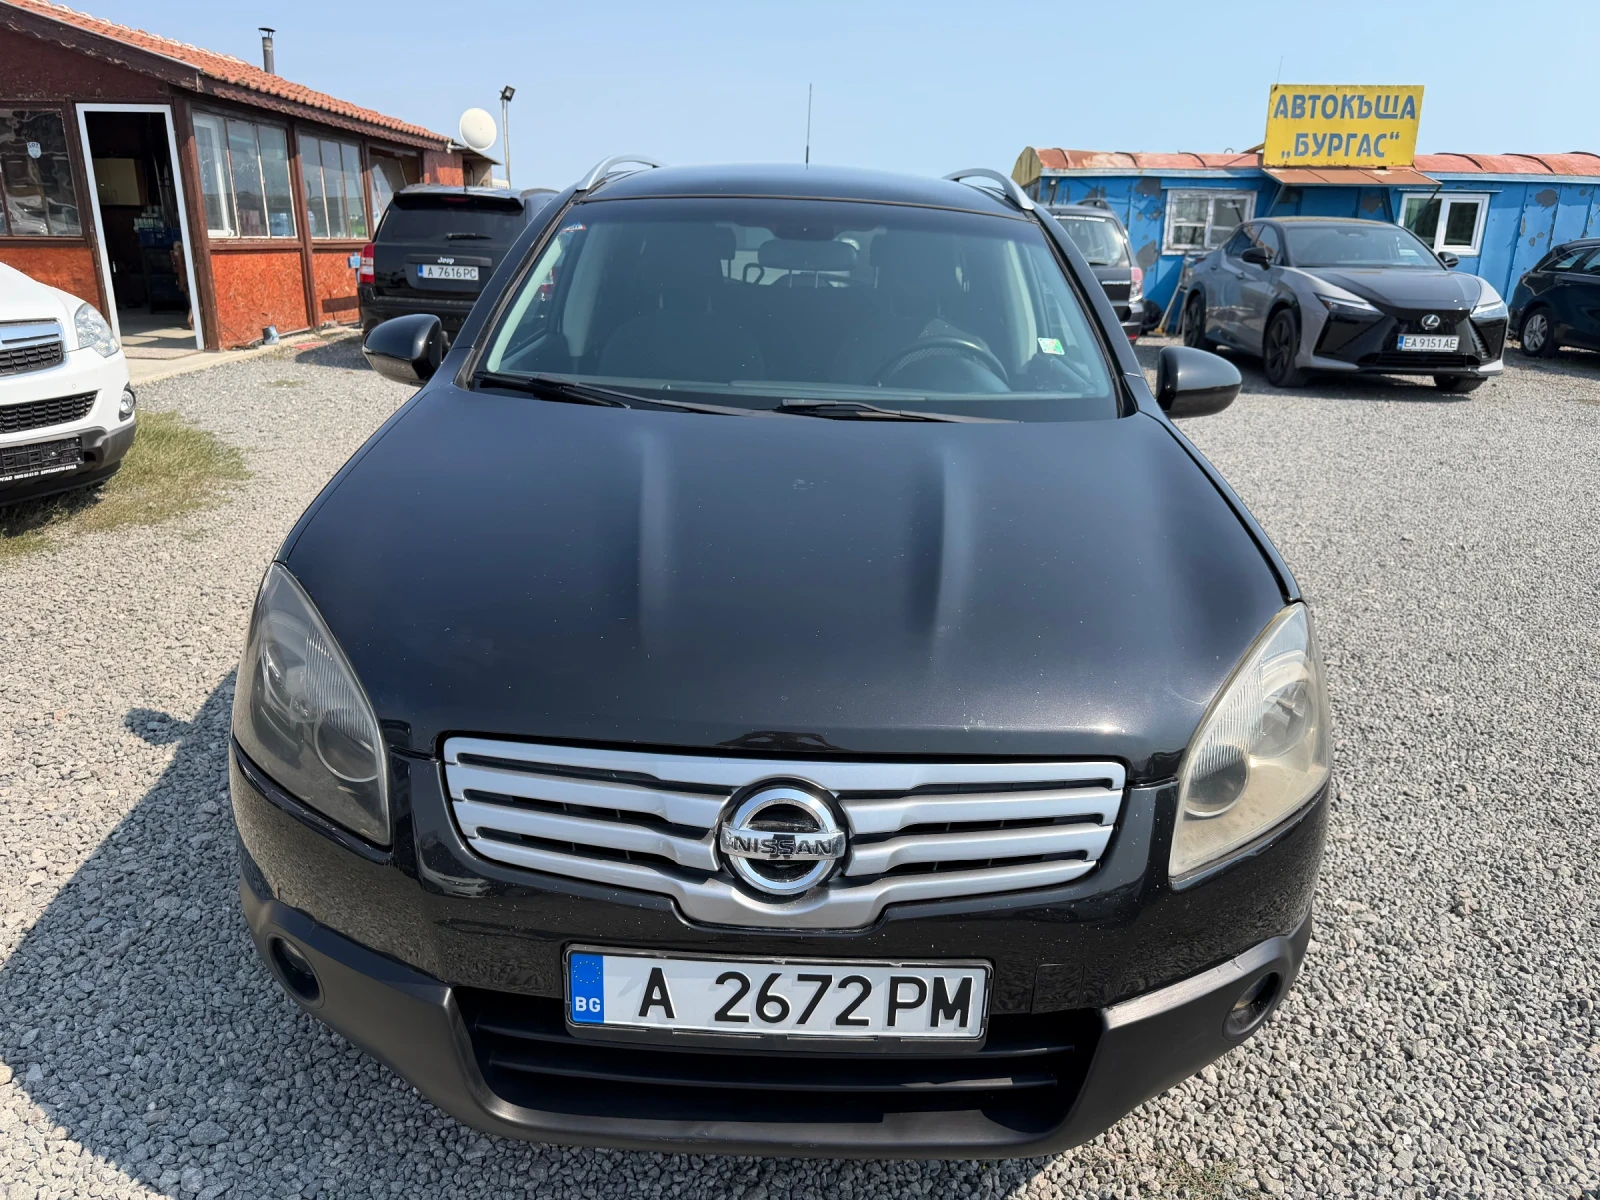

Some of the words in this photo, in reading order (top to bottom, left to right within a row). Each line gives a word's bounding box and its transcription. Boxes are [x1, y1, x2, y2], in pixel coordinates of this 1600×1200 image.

[437, 256, 454, 264] Jeep
[438, 267, 462, 278] 7616
[1404, 337, 1417, 348] EA
[1419, 338, 1442, 348] 9151
[1442, 338, 1457, 349] AE
[732, 836, 833, 856] NISSAN
[575, 996, 601, 1013] BG
[638, 967, 676, 1019] A
[713, 971, 874, 1027] 2672
[886, 975, 974, 1028] PM
